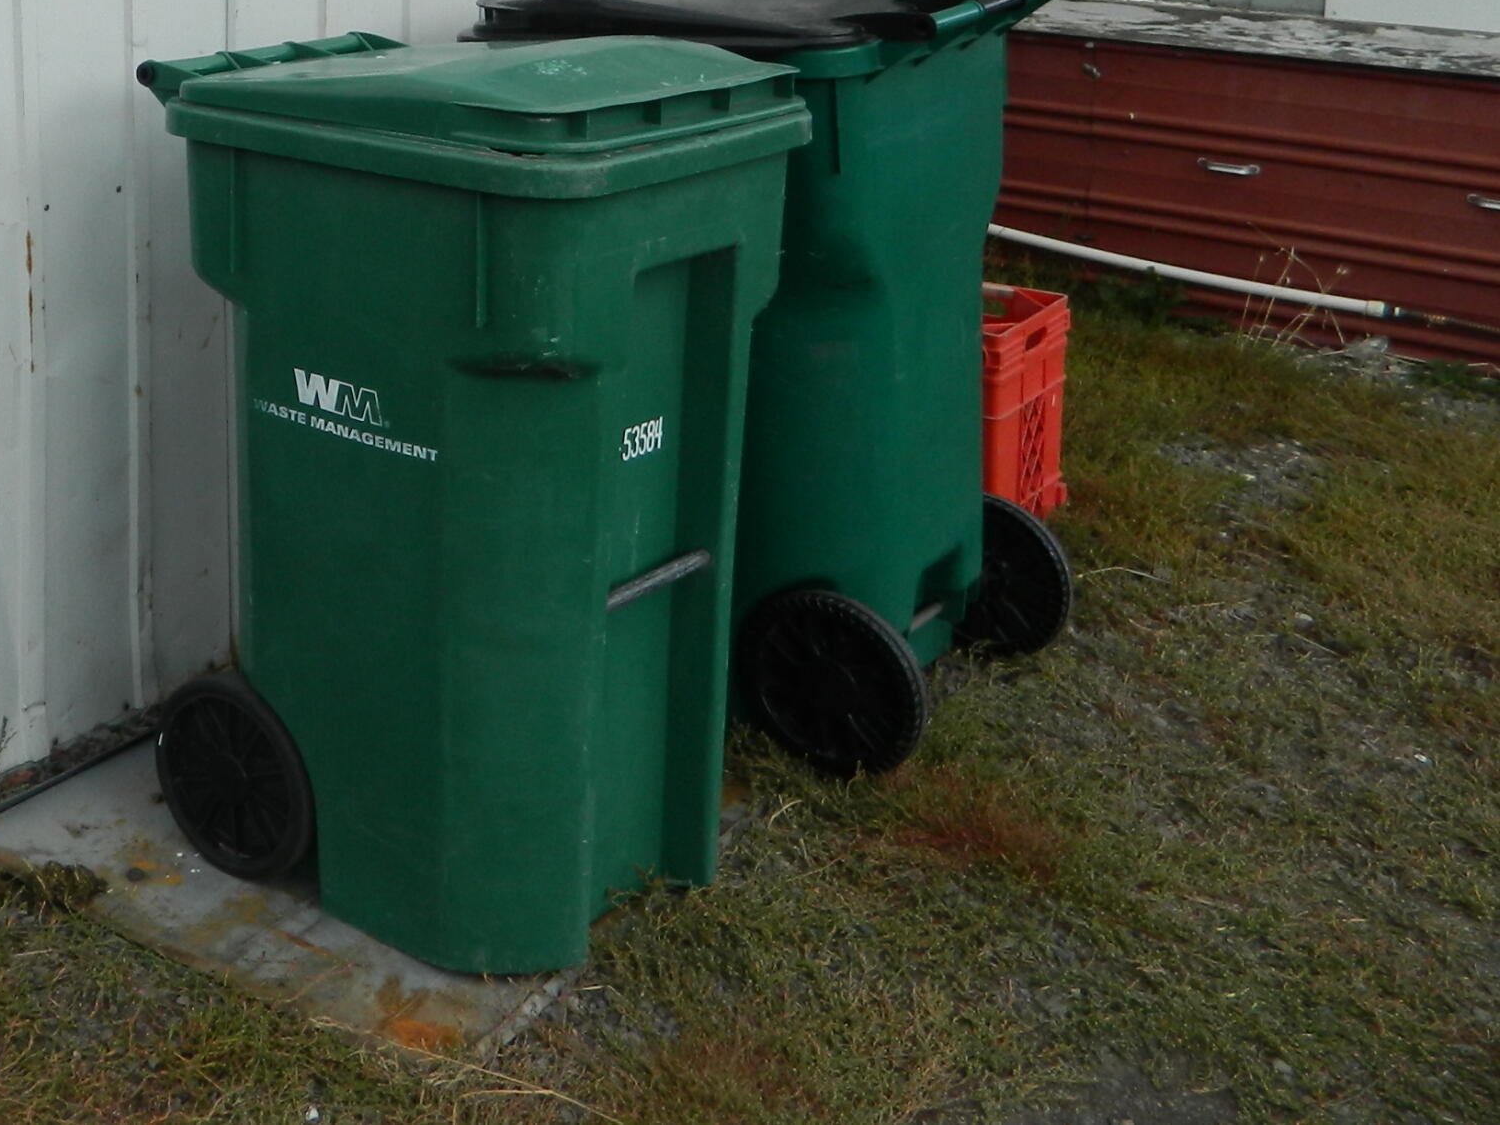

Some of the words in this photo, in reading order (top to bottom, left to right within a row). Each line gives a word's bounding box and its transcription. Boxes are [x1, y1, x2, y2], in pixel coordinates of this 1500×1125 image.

[293, 367, 383, 427] WM
[253, 398, 307, 426] WASTE
[310, 415, 439, 463] MANAGEMENT
[622, 416, 664, 462] 53584
